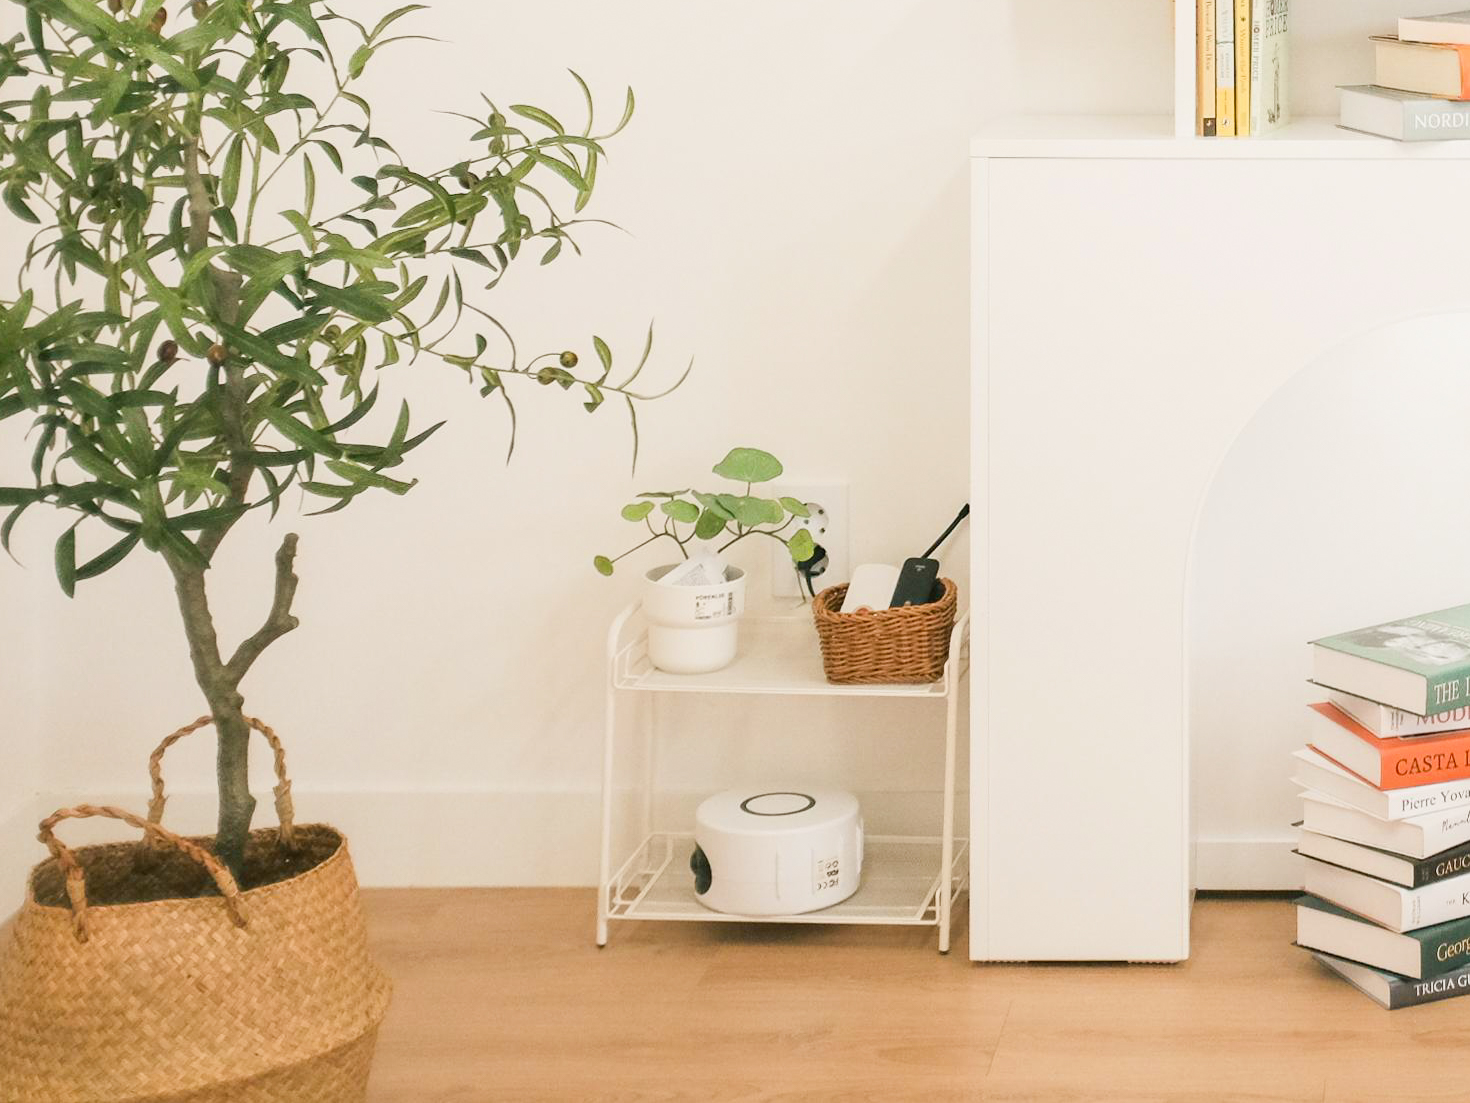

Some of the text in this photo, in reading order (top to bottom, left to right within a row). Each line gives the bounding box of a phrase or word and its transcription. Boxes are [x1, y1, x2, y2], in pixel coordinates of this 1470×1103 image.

[1433, 679, 1460, 706] THE
[1395, 752, 1459, 777] CASTA
[1400, 797, 1437, 812] Pierre
[1413, 977, 1456, 998] TRICIA
